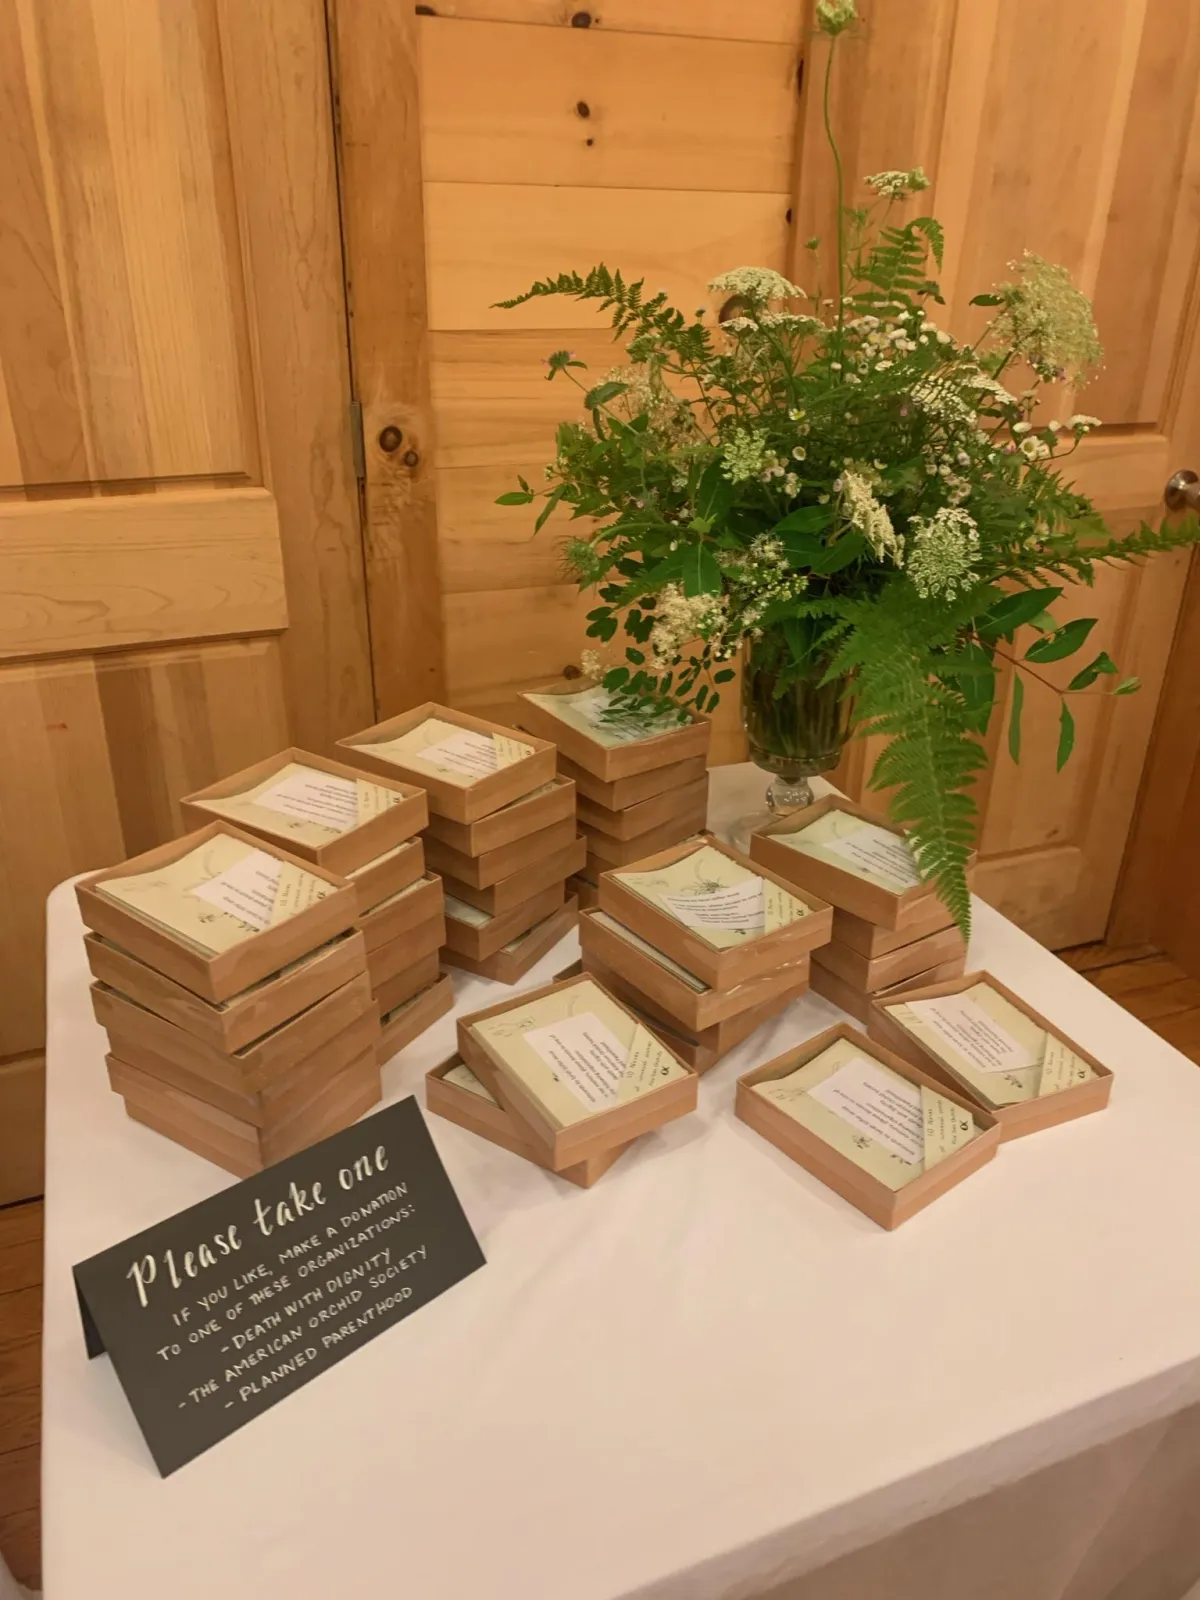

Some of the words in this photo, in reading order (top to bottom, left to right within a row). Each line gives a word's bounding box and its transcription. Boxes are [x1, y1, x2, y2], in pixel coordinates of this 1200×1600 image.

[127, 1224, 242, 1308] Please
[254, 1181, 327, 1236] take
[338, 1145, 389, 1191] one
[172, 1306, 191, 1327] IF
[196, 1285, 228, 1312] YOU
[278, 1234, 322, 1265] MAKE
[326, 1226, 339, 1238] A
[339, 1182, 408, 1228] DONATION
[283, 1287, 324, 1317] WITH
[325, 1247, 390, 1294] DIGNITY
[156, 1343, 181, 1361] TO
[188, 1319, 223, 1344] ONE
[226, 1302, 243, 1321] OF
[248, 1275, 291, 1306] THESE
[224, 1325, 303, 1383] AMERICAN
[308, 1290, 363, 1328] ORCHID
[368, 1244, 427, 1289] SOCIETY
[321, 1286, 413, 1349] PARENTHOOD
